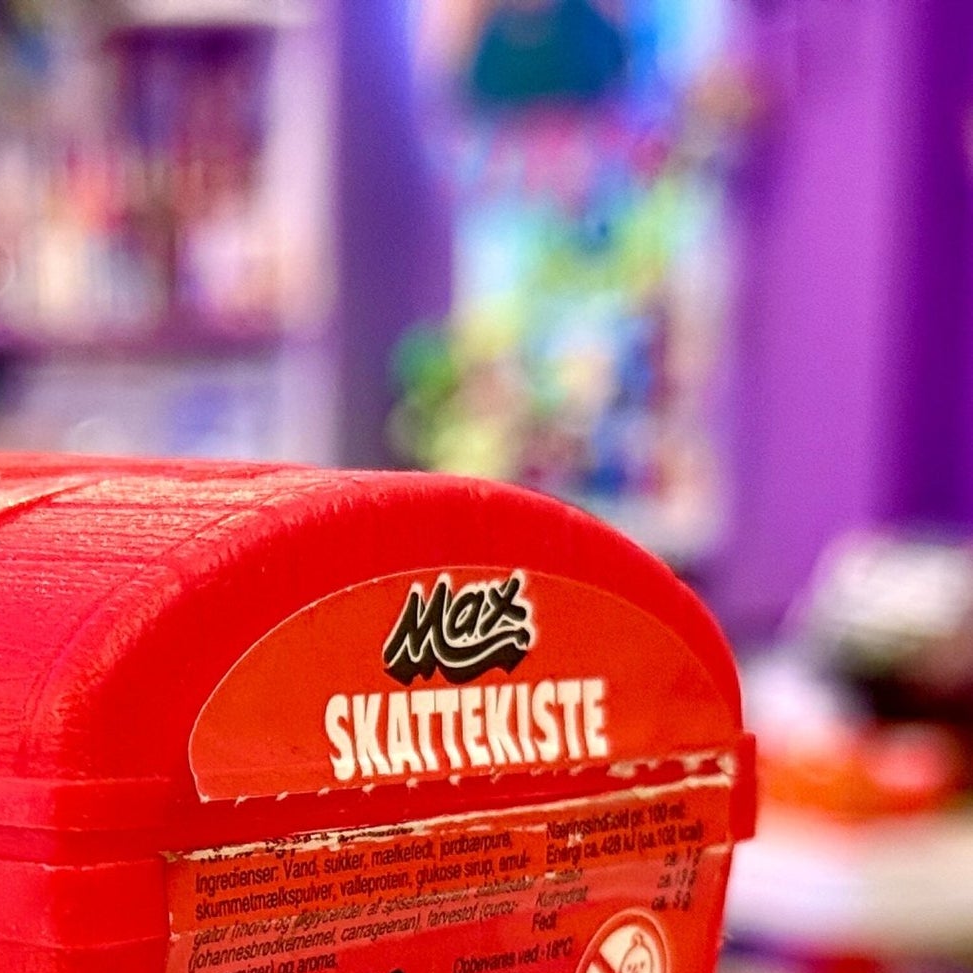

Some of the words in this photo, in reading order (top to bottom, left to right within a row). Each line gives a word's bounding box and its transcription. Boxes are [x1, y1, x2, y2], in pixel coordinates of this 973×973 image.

[383, 569, 535, 686] Max
[325, 678, 608, 781] SKATTEKISTE
[283, 855, 320, 880] Vand,
[324, 850, 369, 874] sukker,
[415, 863, 461, 893] glukose
